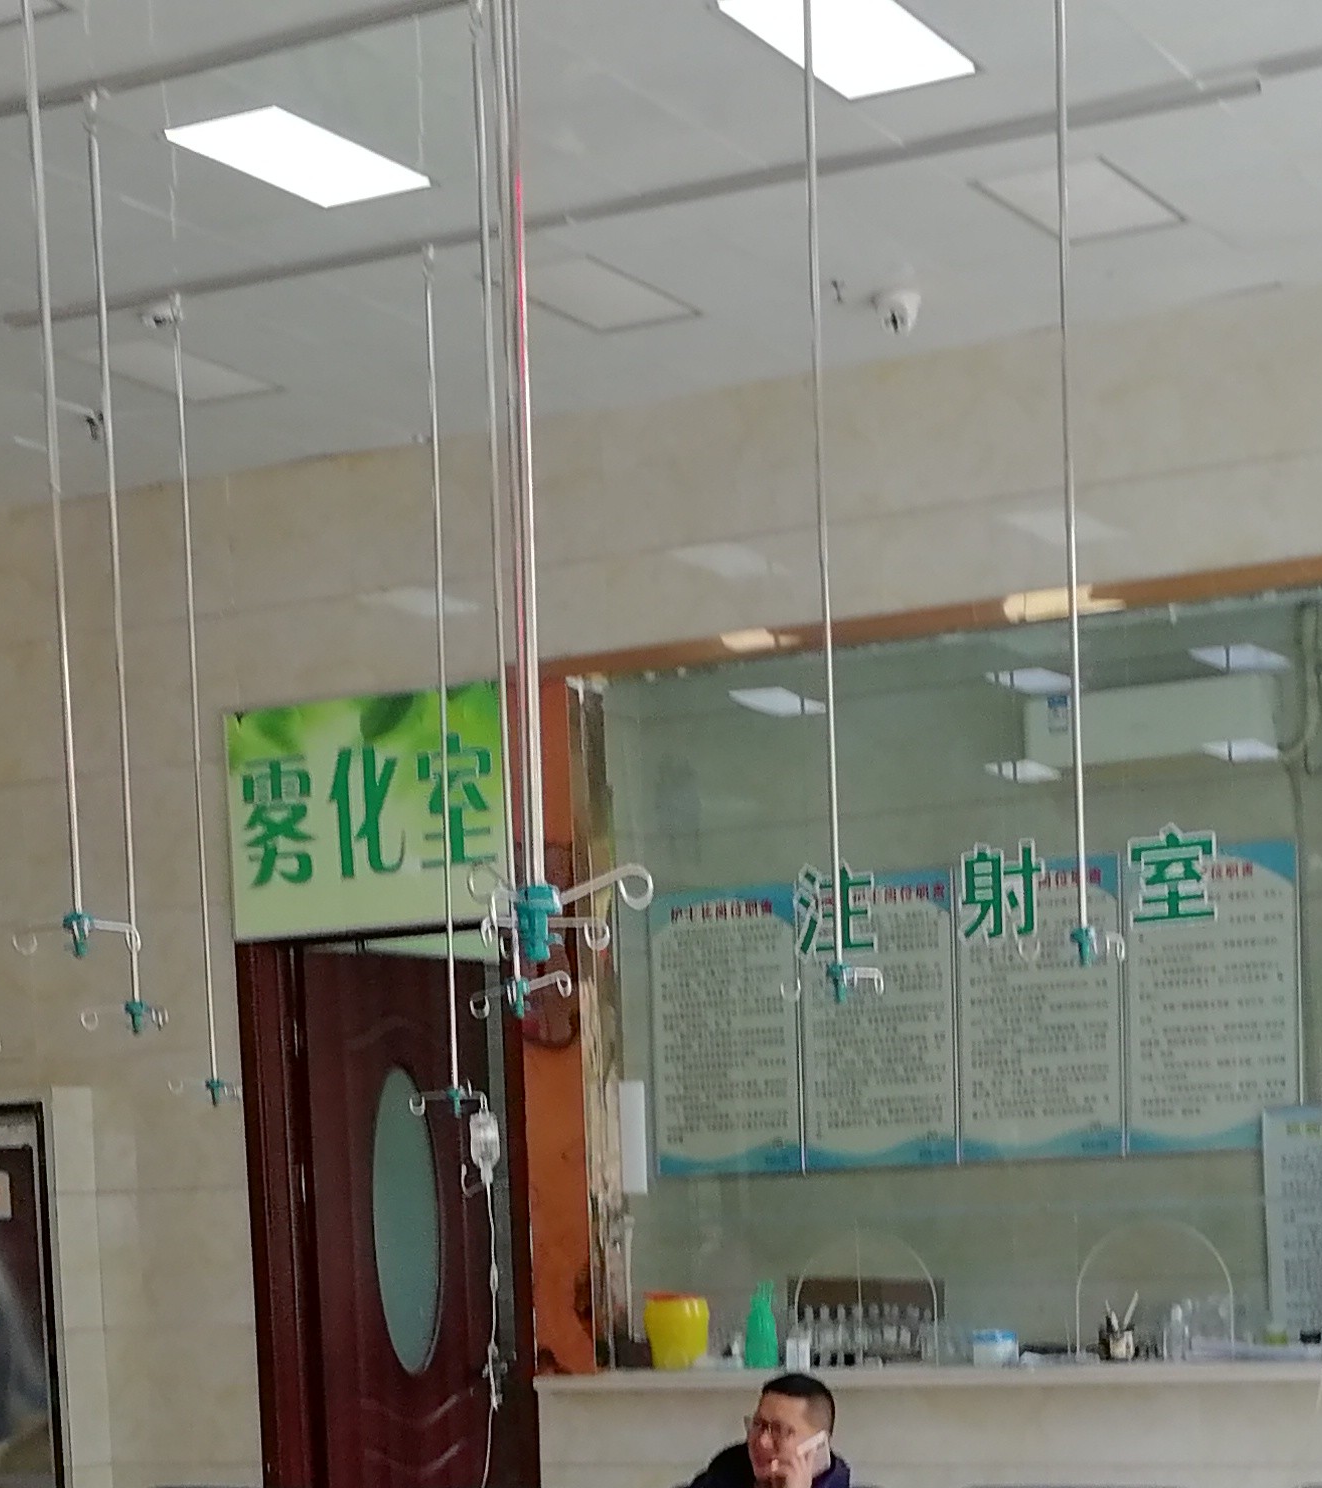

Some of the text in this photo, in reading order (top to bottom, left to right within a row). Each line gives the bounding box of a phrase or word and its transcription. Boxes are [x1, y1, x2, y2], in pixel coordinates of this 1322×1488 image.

[241, 732, 498, 888] 雾化室
[796, 826, 1218, 958] 注射室
